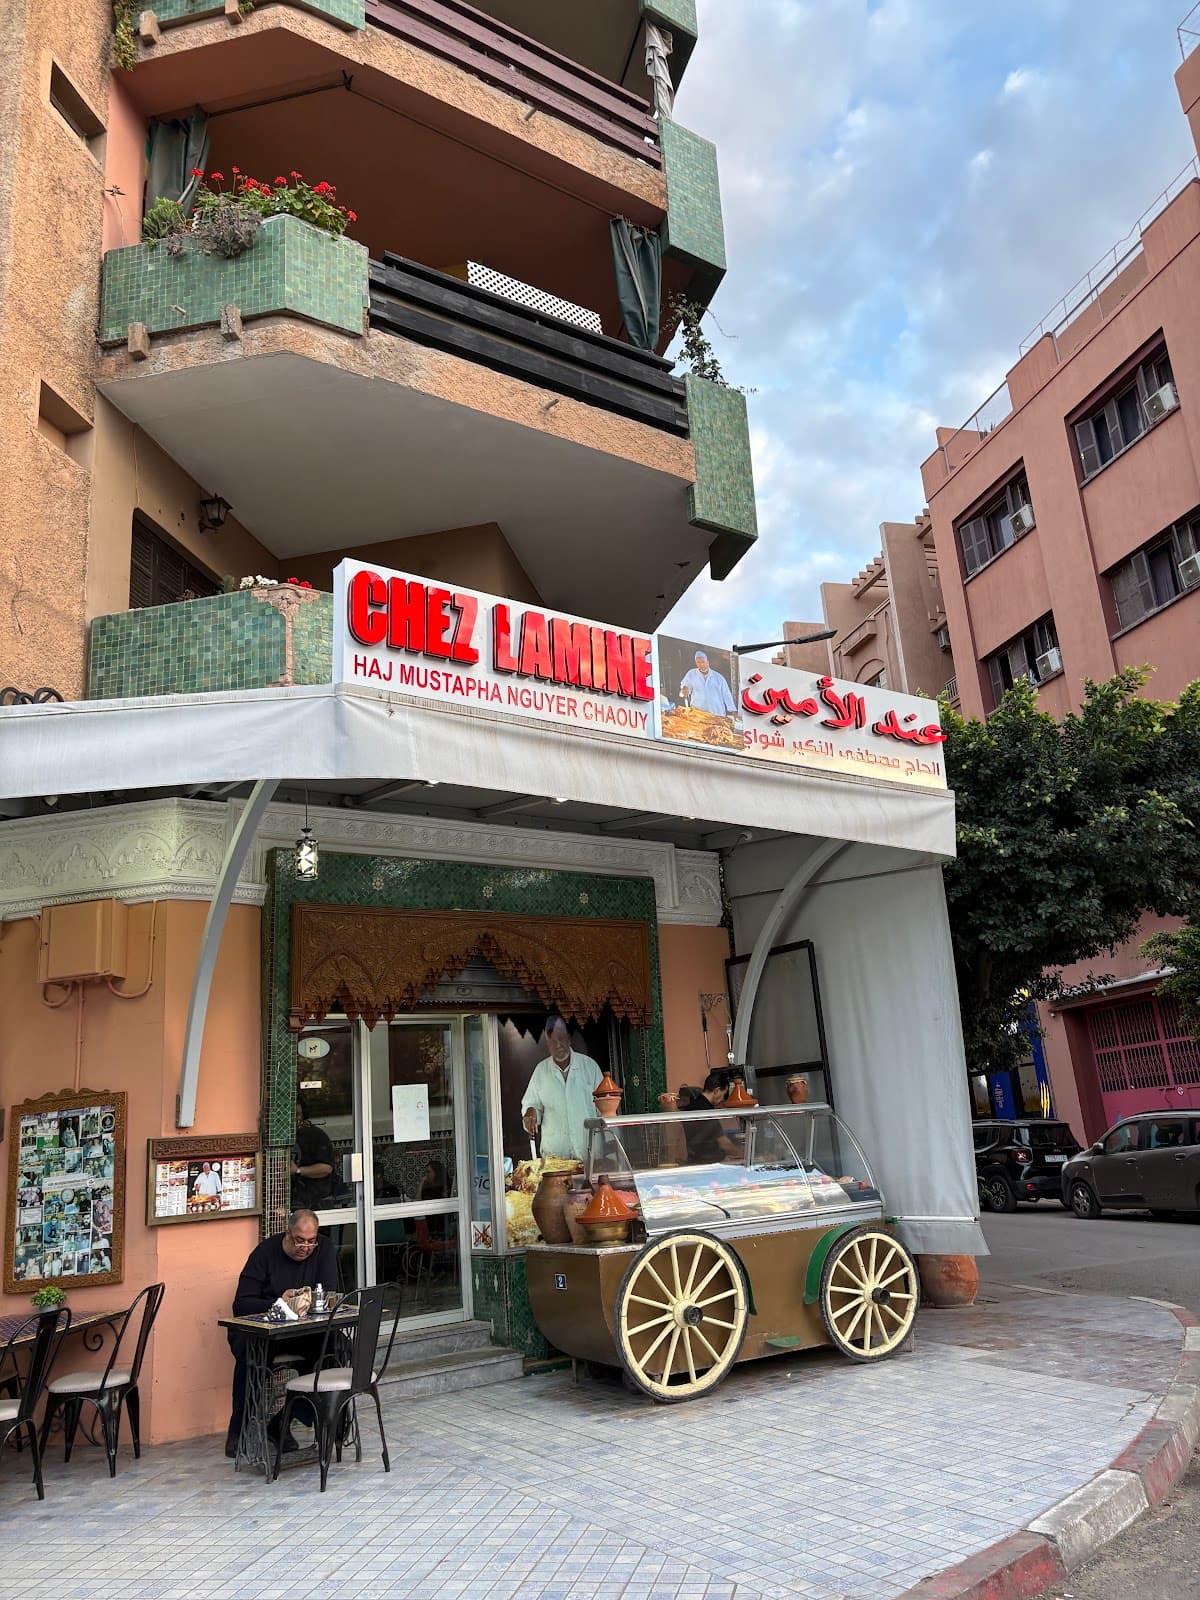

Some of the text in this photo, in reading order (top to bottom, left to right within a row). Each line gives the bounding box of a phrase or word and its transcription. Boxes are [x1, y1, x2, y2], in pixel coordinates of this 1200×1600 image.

[348, 570, 654, 701] CHEZ LAMINE
[354, 654, 648, 730] HAJ MUSTAPHA NGUYER CHAOUY
[742, 673, 948, 745] عند الأمين
[905, 758, 940, 776] الحاج
[558, 1276, 564, 1287] 2
